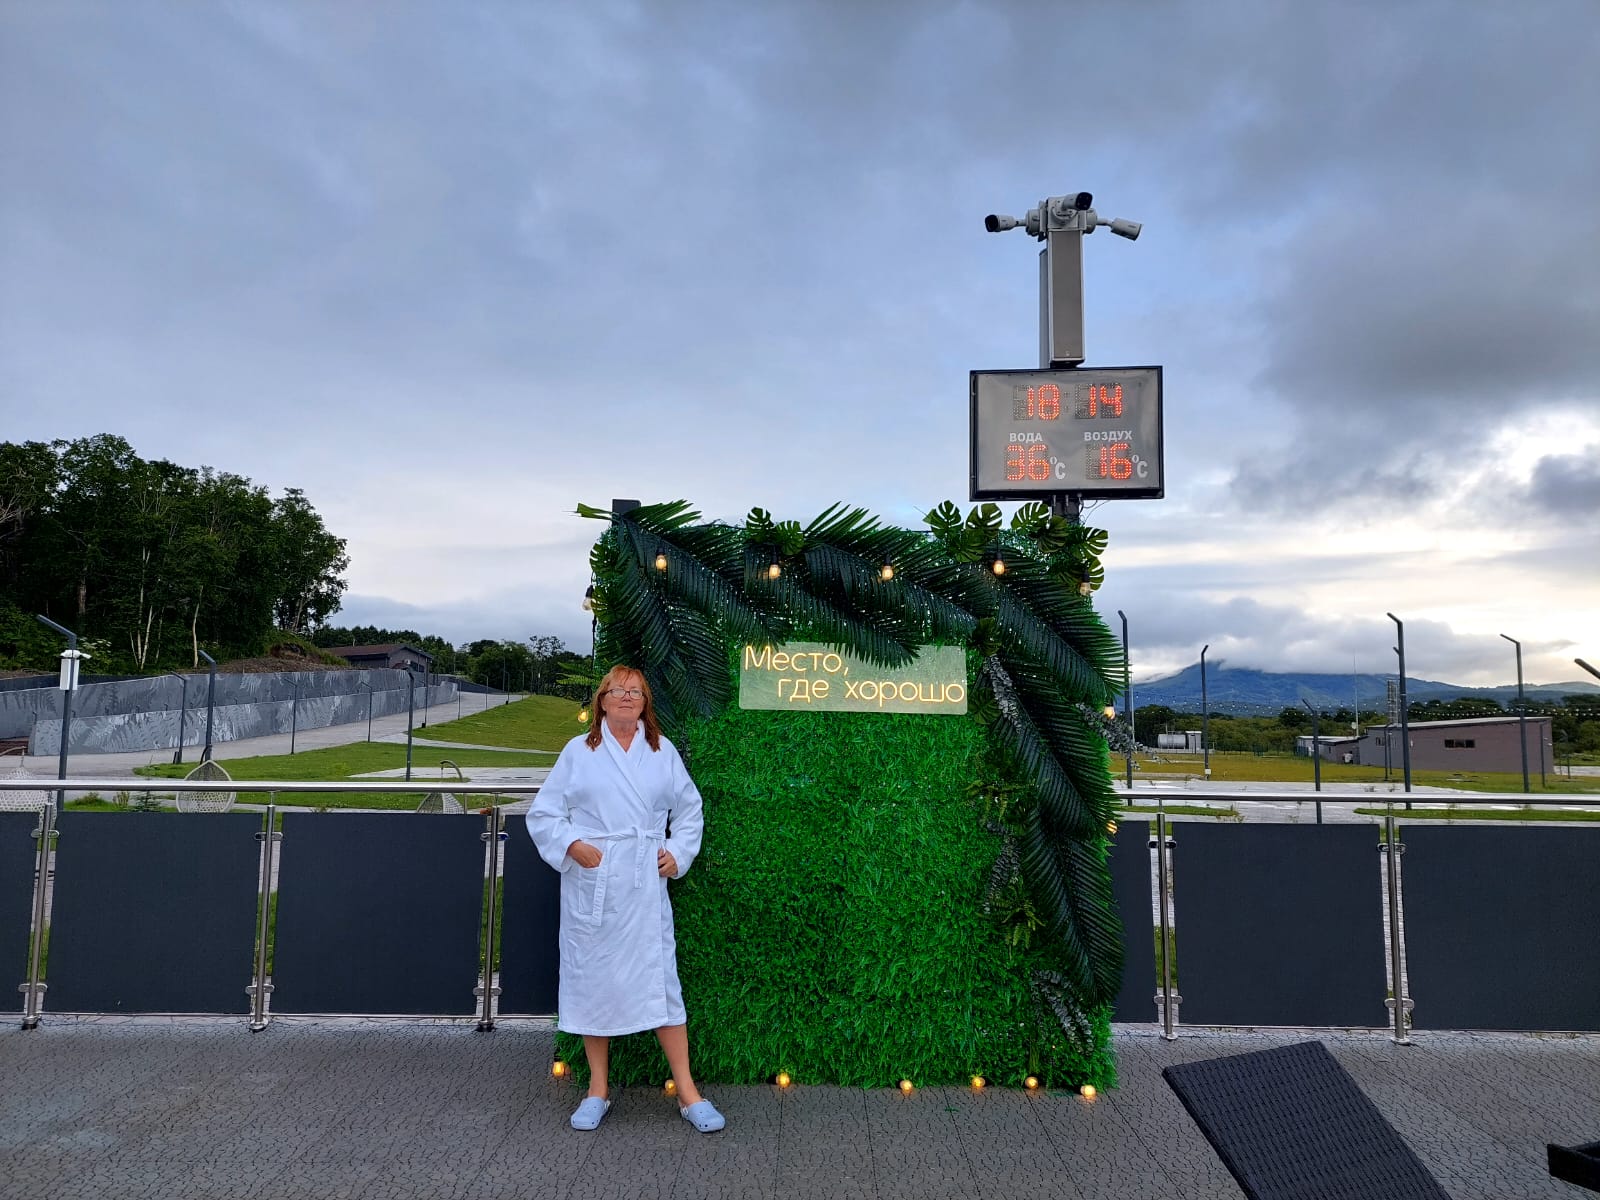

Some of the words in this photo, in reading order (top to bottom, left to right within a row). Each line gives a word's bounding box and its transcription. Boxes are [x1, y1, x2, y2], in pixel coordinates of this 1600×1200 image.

[1009, 432, 1043, 443] ВОДА
[1083, 430, 1133, 442] ВОЗДУХ
[744, 645, 849, 676] Место,
[777, 678, 830, 703] где
[844, 680, 965, 707] хорошо
